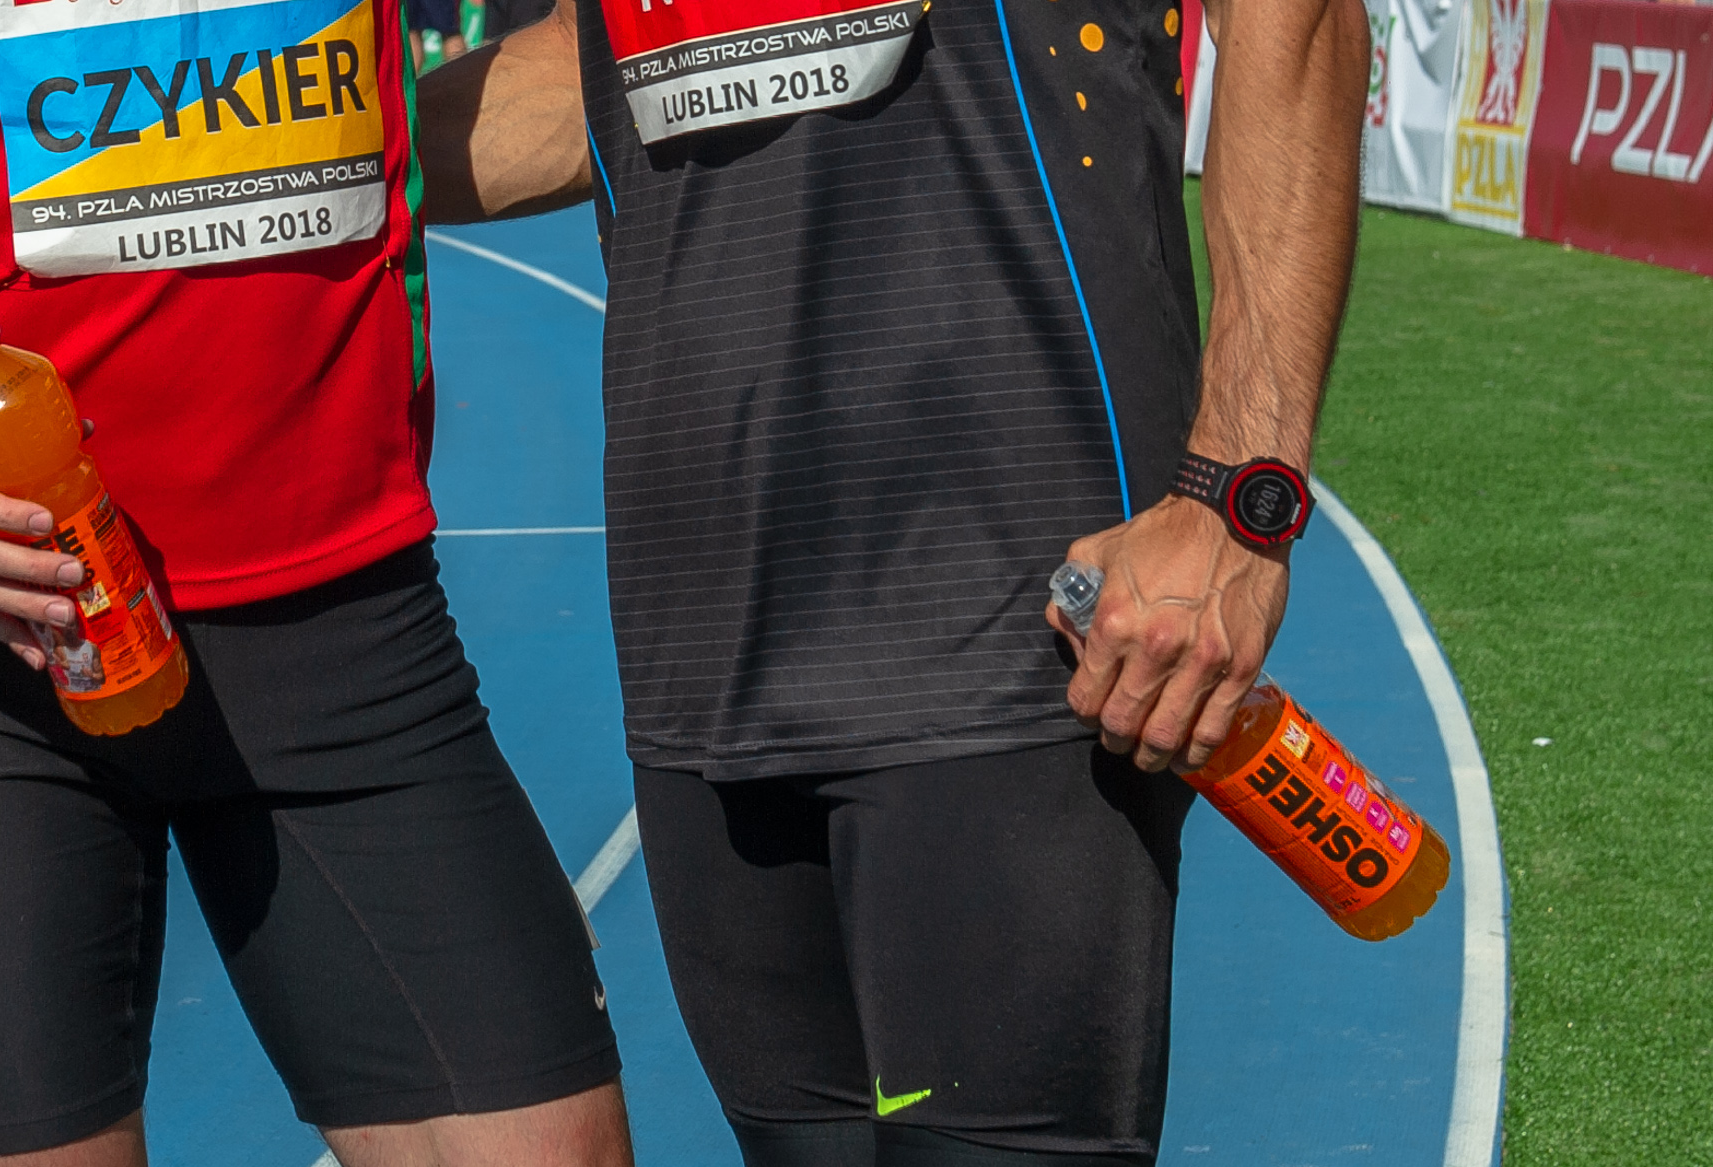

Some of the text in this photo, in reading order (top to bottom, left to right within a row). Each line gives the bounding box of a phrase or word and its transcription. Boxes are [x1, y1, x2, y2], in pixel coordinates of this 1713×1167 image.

[640, 57, 678, 79] PZLA
[678, 26, 834, 69] MISTRZOSTWA
[836, 11, 911, 40] POLSKI
[26, 38, 367, 153] CZYKIER
[661, 64, 850, 126] LUBLIN 2018
[32, 160, 378, 225] 94. PZLA MISTRZOSTWA POLSKI
[1455, 133, 1518, 205] PZLA
[118, 207, 332, 263] LUBLIN 2018
[1245, 753, 1389, 888] OSHEE
